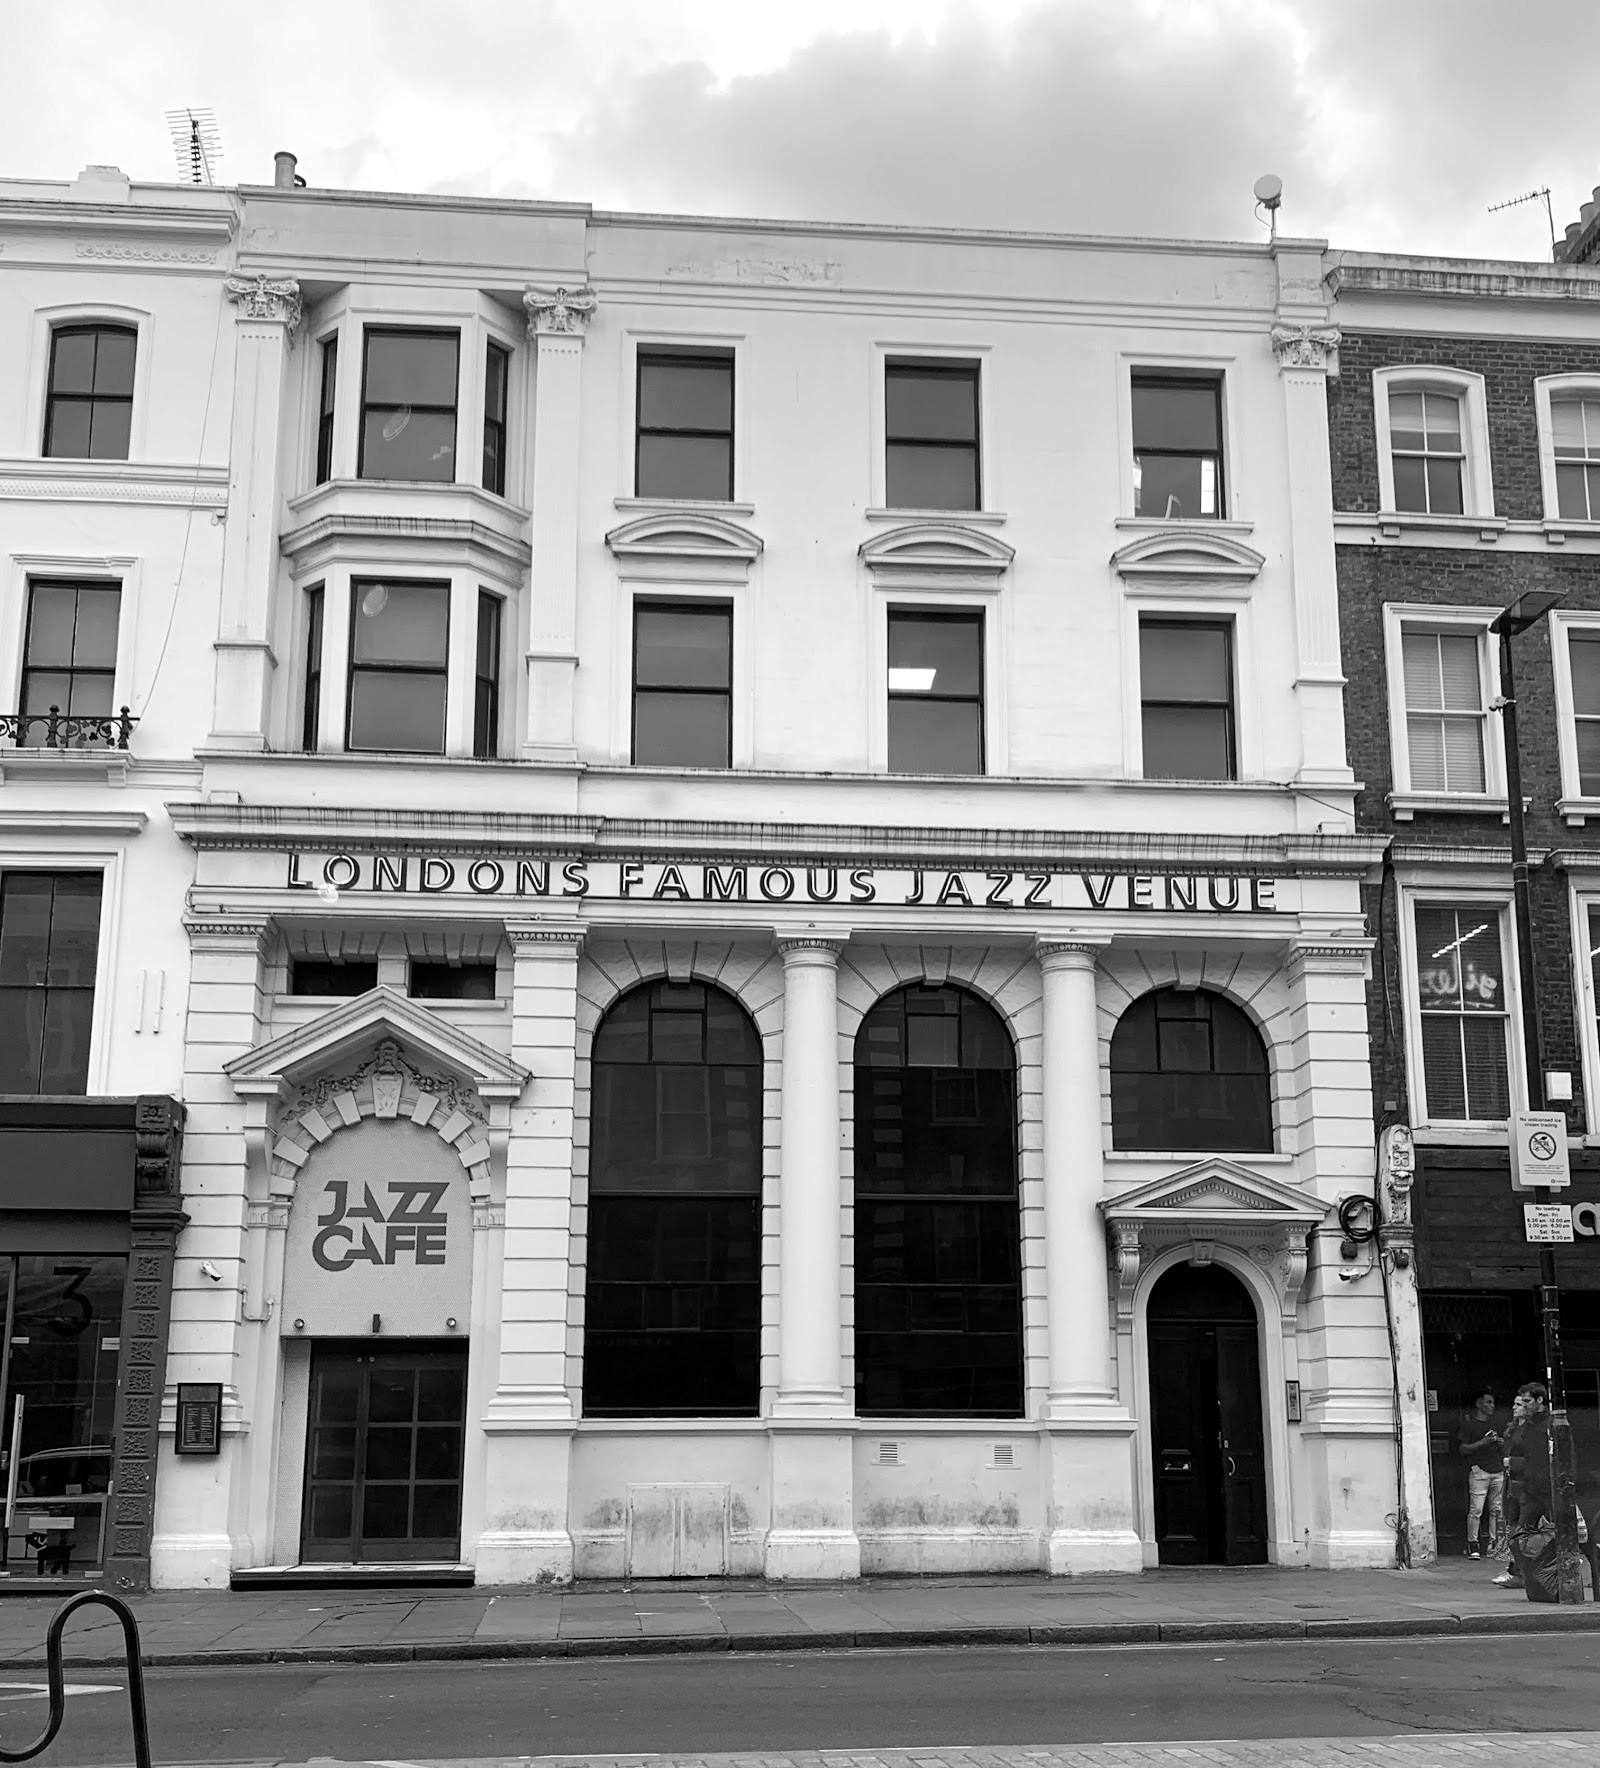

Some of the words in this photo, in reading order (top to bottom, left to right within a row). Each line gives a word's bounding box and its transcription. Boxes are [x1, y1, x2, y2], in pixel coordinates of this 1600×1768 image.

[287, 853, 588, 896] LONDONS
[619, 863, 876, 903] FAMOUS
[905, 870, 1052, 907] JAZZ
[1083, 875, 1277, 912] VENUE
[317, 1180, 449, 1226] JAZZ
[312, 1222, 447, 1272] CAFE
